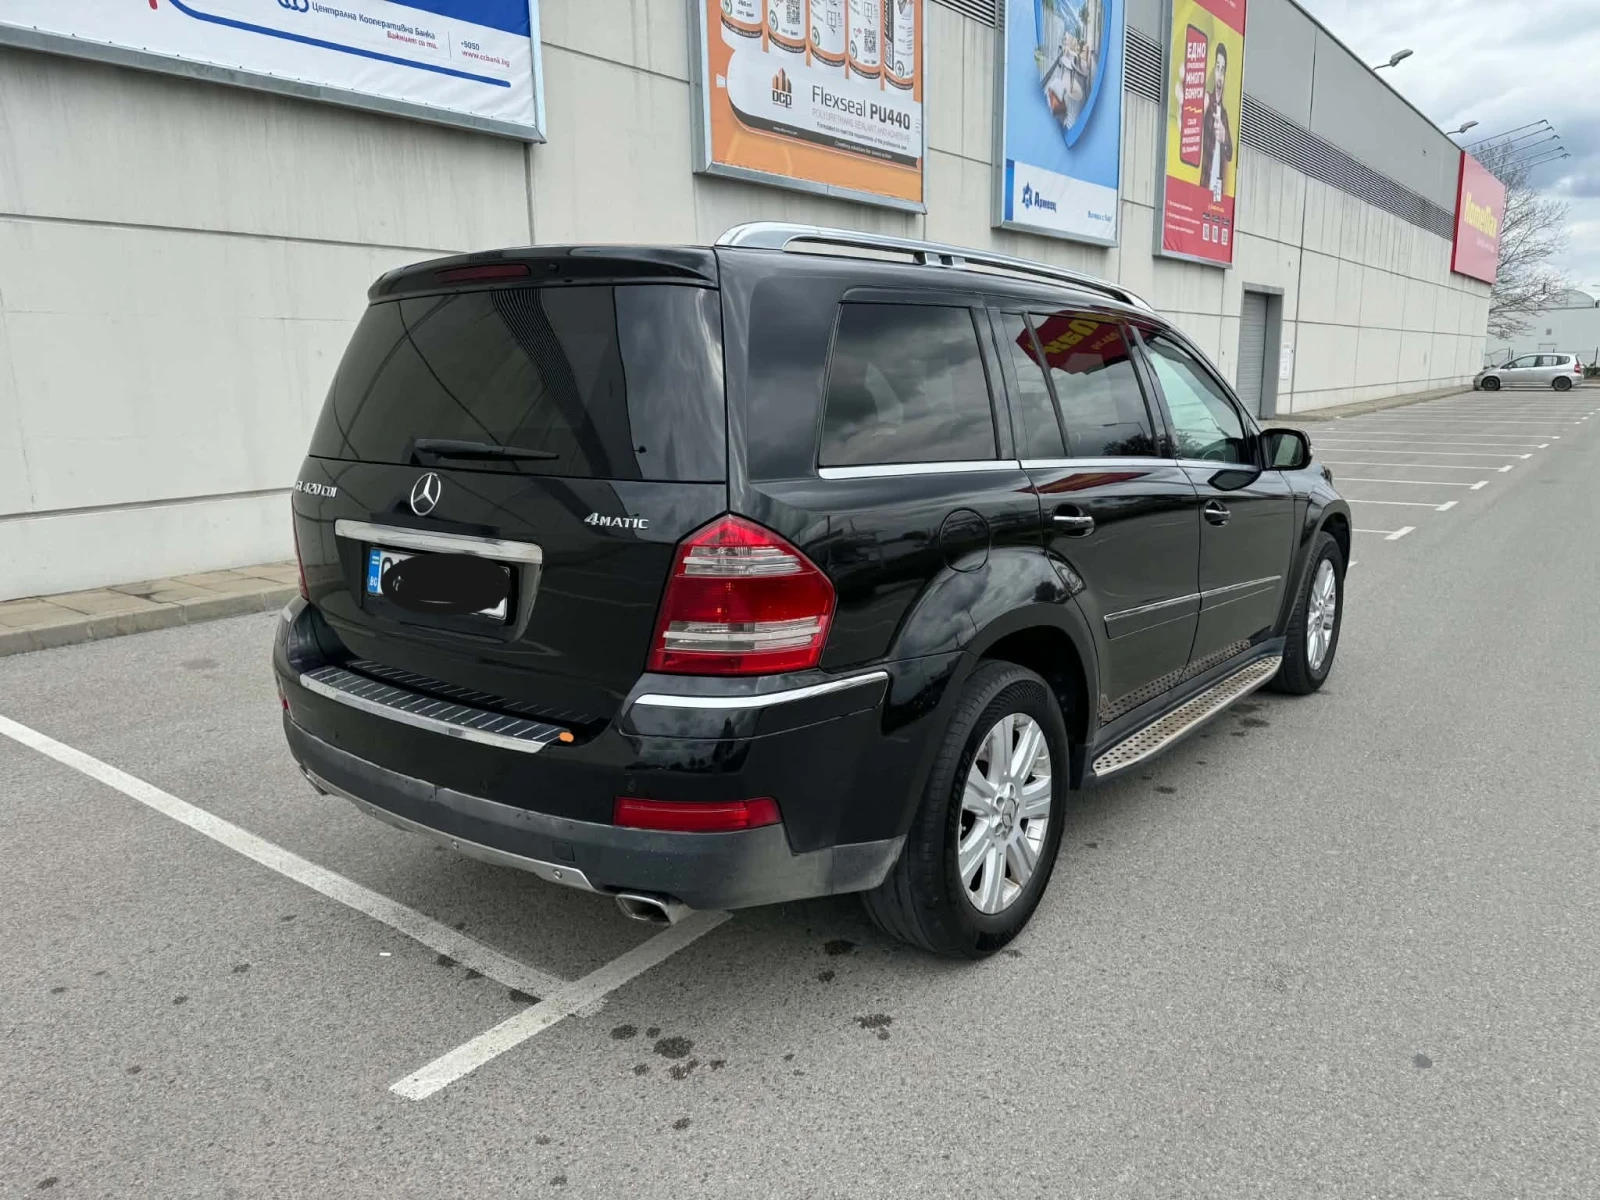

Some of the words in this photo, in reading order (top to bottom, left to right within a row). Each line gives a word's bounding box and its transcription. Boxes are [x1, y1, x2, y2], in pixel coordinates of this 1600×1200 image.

[312, 2, 357, 21] Централна
[359, 13, 414, 35] Кооперативна
[415, 27, 436, 40] Банка
[1187, 42, 1206, 61] ЕДНО
[1185, 71, 1205, 85] МНОГО
[812, 85, 866, 118] Flexseal
[869, 103, 911, 130] PU440
[1034, 191, 1056, 213] Армеец
[584, 512, 650, 529] 4MATIC
